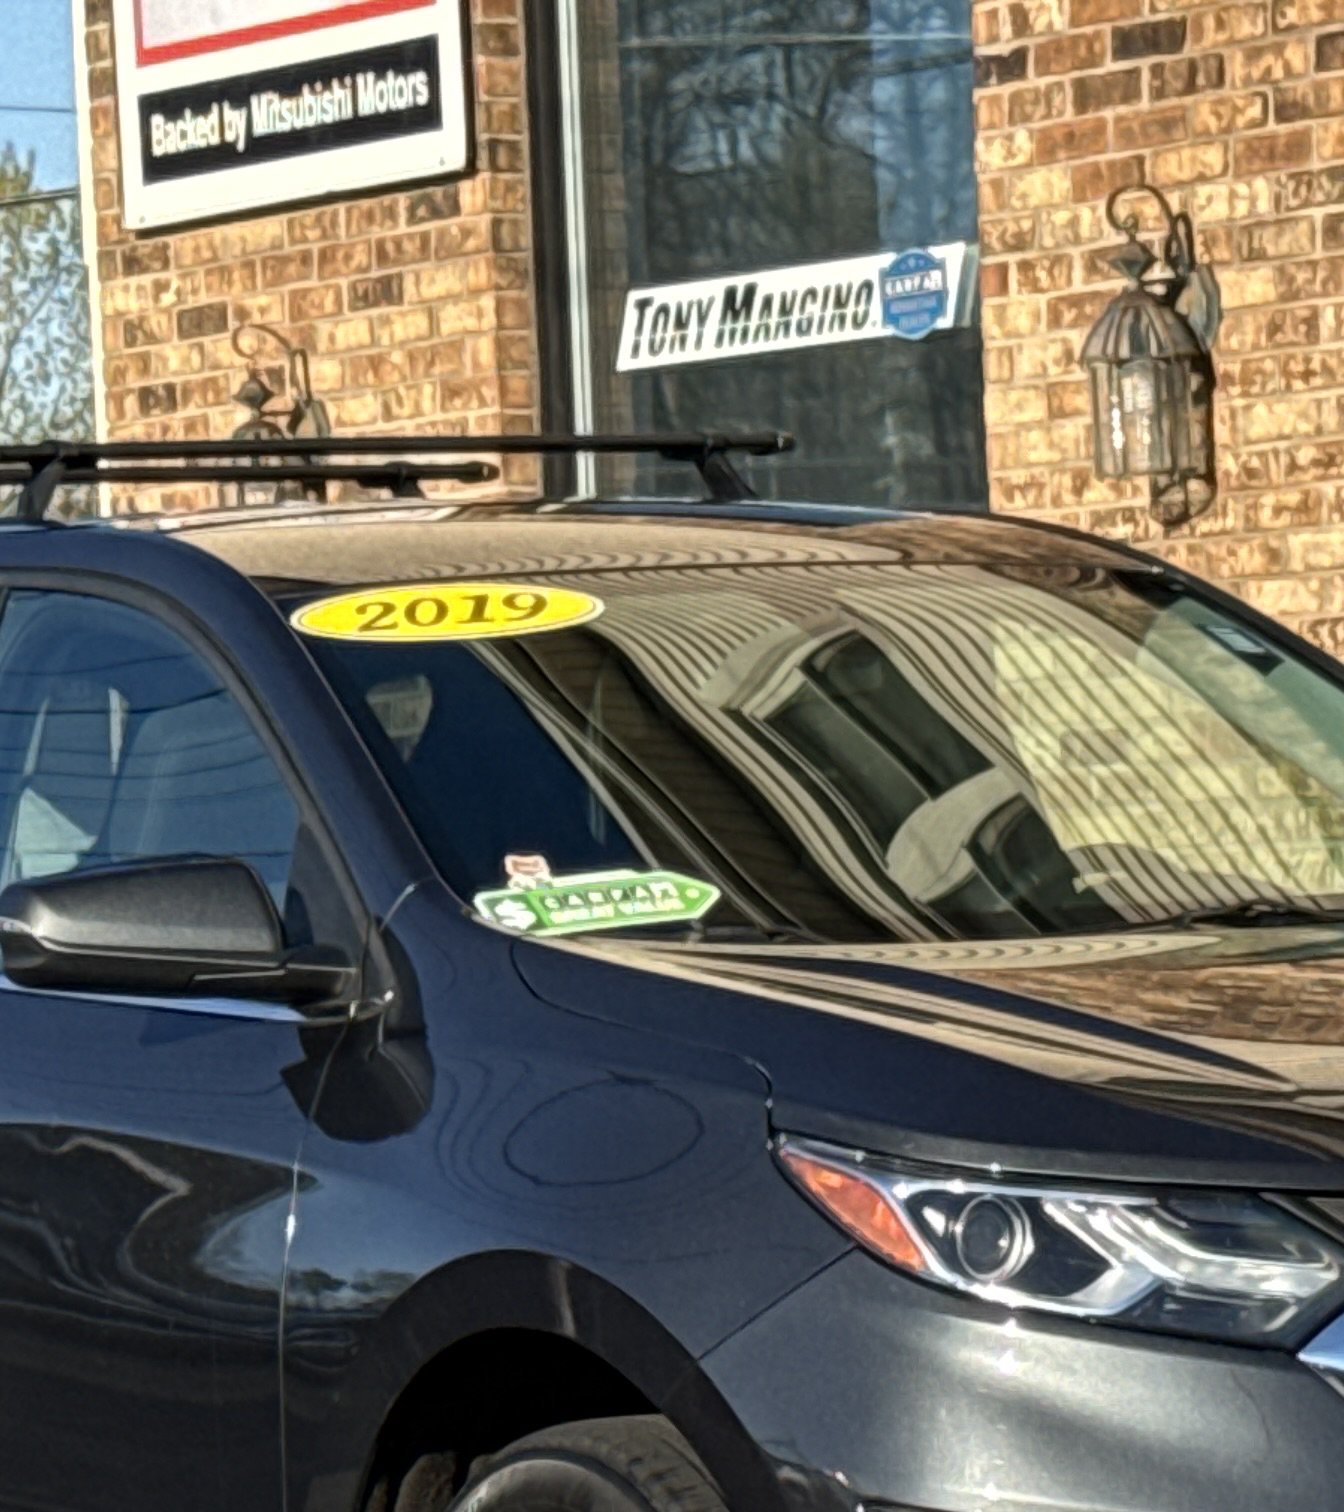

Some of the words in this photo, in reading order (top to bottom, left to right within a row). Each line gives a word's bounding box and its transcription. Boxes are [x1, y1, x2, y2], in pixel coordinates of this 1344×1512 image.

[150, 102, 220, 157] Backed
[222, 100, 248, 153] by
[250, 75, 353, 137] Mitsubishi
[356, 68, 430, 117] Motors
[630, 296, 715, 360] TONY
[354, 591, 548, 633] 2019
